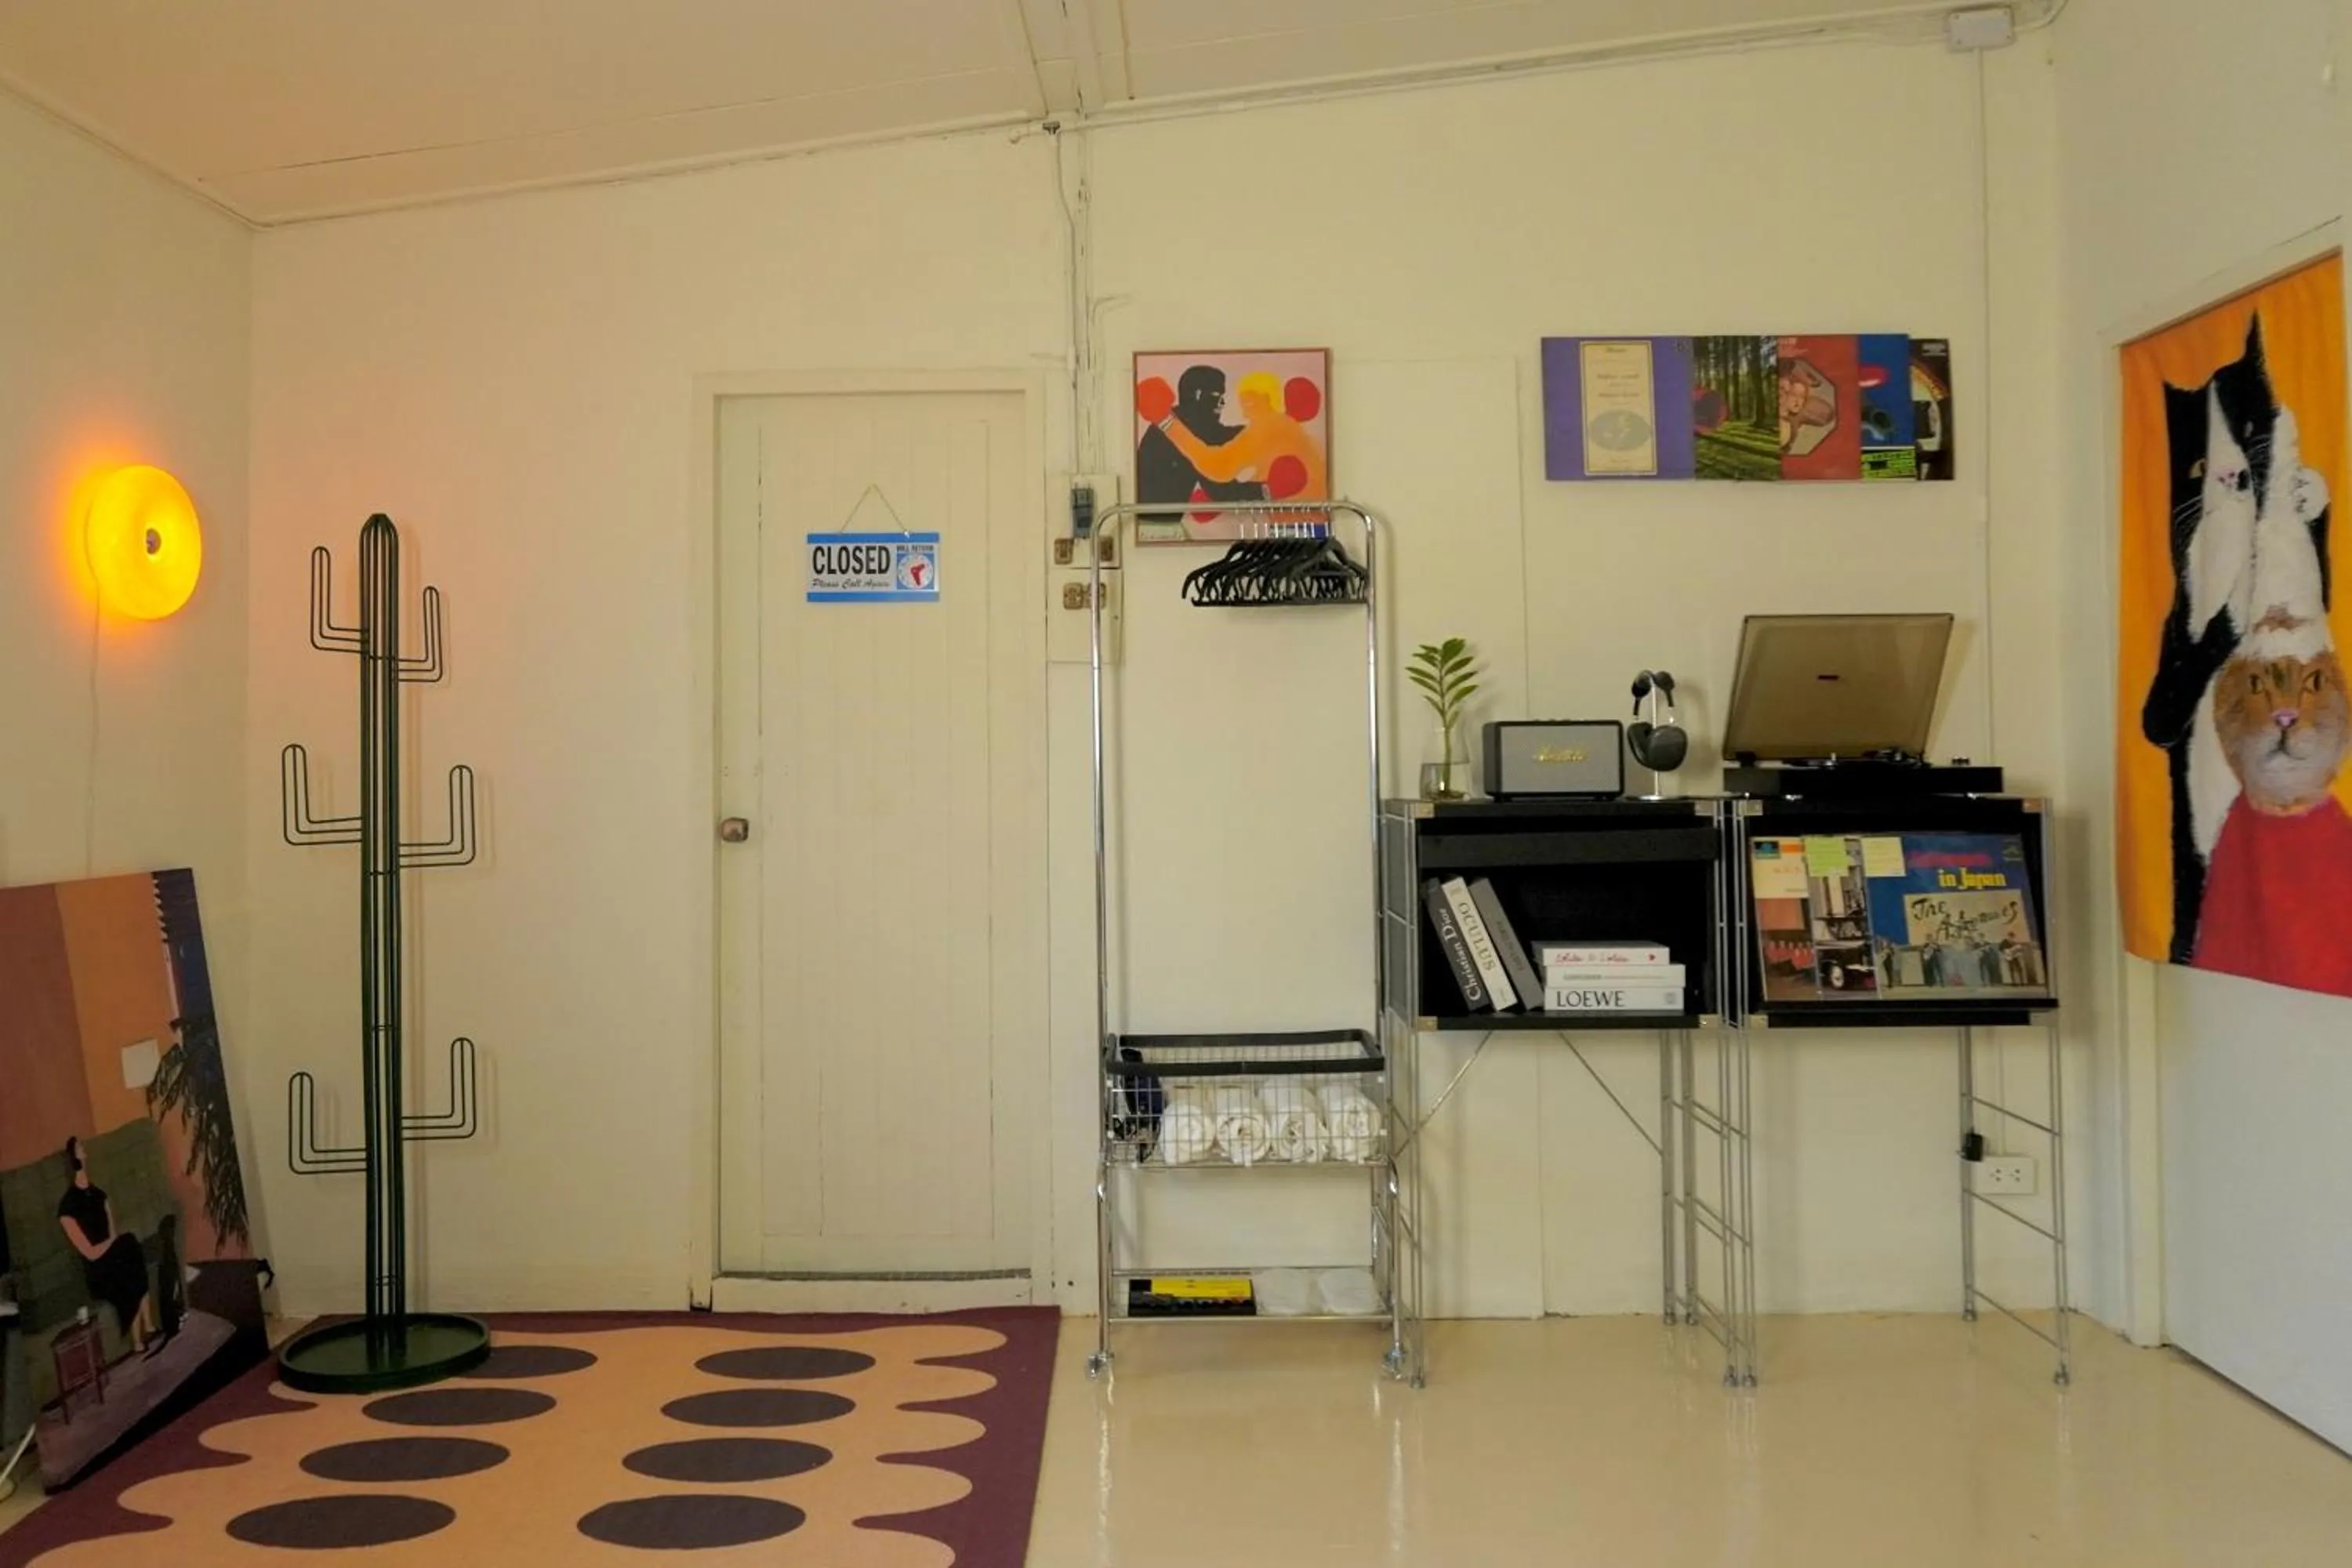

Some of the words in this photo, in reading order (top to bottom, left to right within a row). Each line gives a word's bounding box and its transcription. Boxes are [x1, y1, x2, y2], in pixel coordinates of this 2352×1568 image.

[813, 546, 891, 575] CLOSED
[1938, 868, 1957, 887] in
[1958, 867, 2008, 889] Japan
[1439, 908, 1458, 942] Dior
[1454, 942, 1482, 1001] Christian
[1556, 990, 1626, 1007] LOEWE
